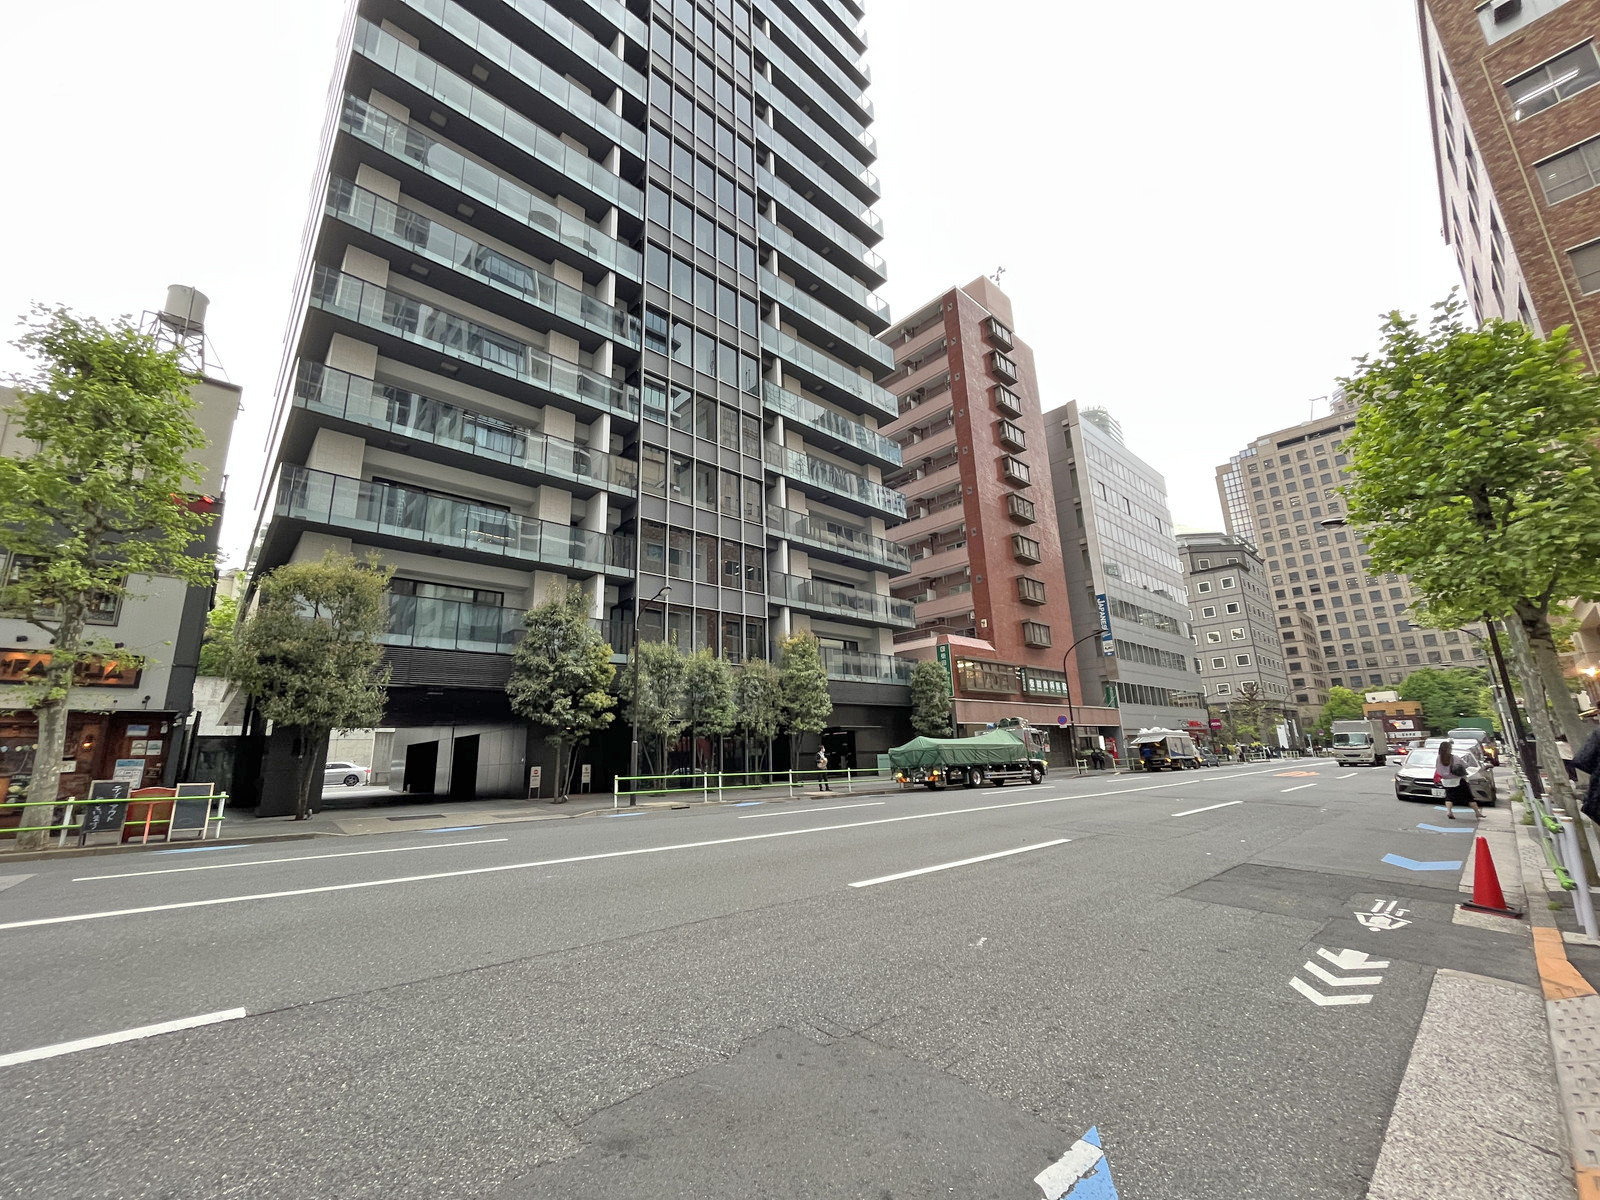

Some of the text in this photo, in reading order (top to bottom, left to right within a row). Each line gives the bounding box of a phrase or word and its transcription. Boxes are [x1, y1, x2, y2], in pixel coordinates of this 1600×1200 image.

[1096, 598, 1110, 635] JAPANES
[106, 785, 123, 823] テイアウト
